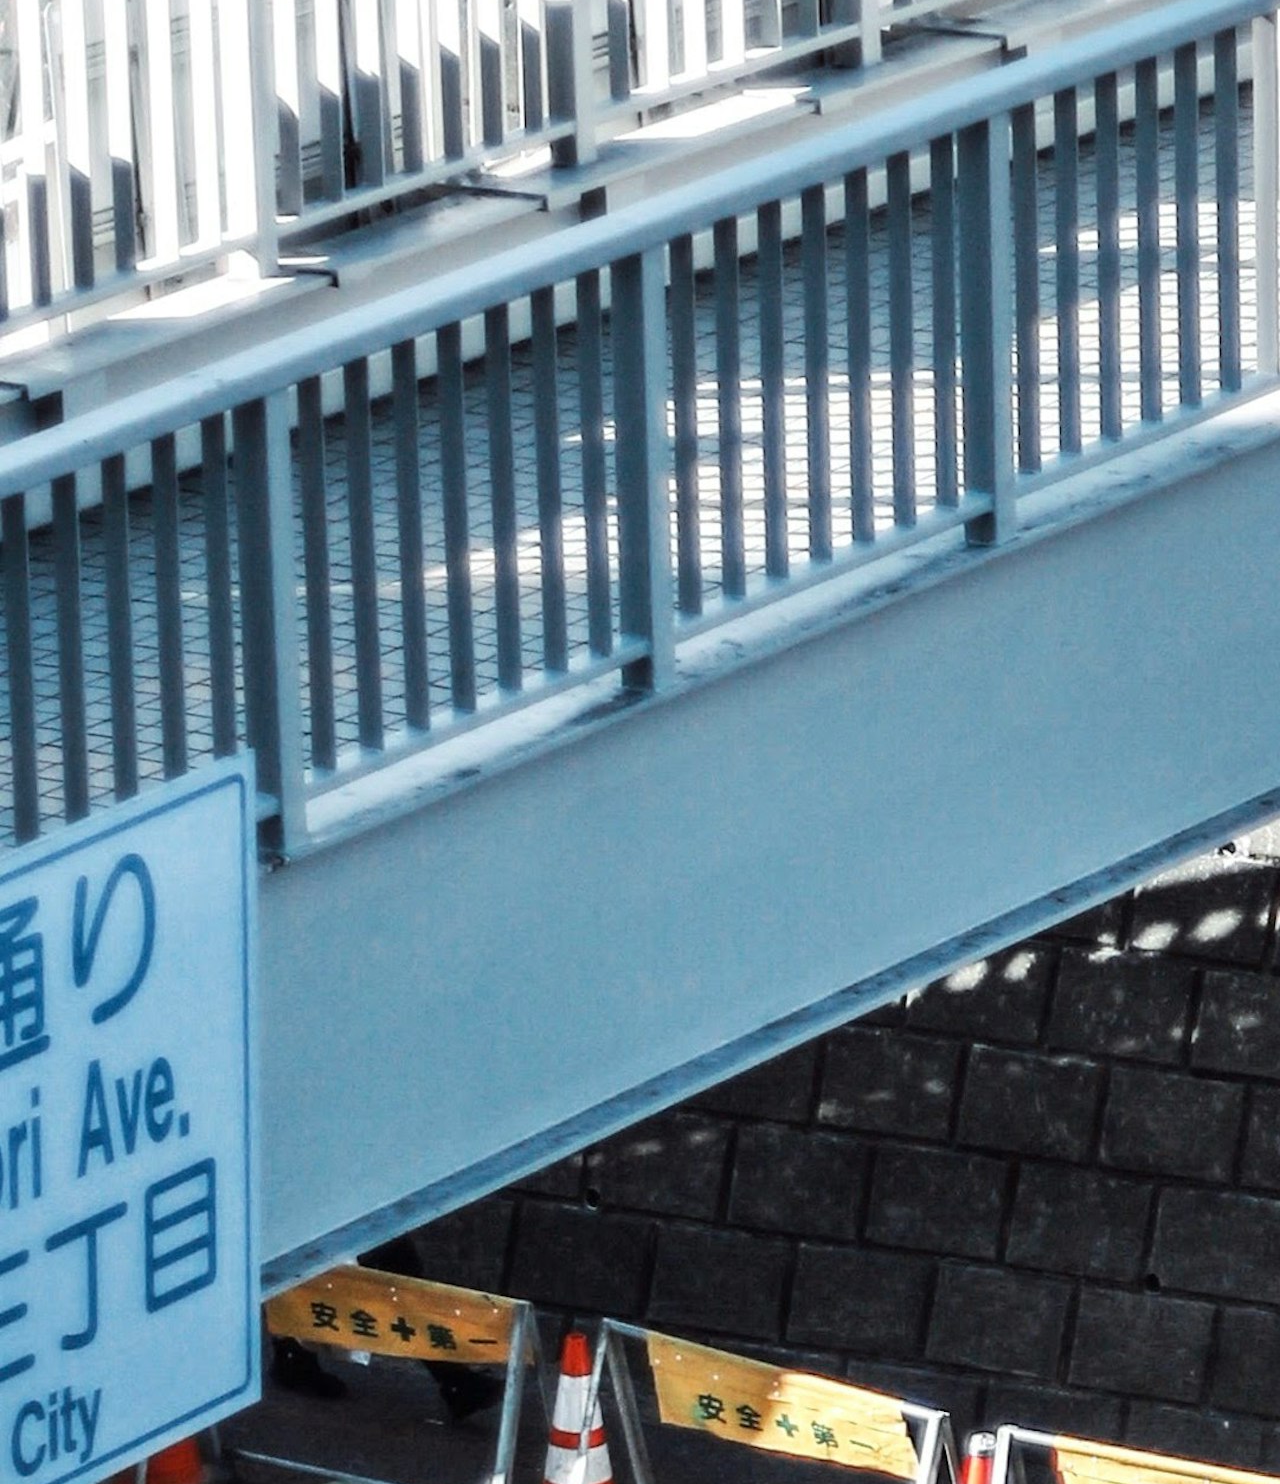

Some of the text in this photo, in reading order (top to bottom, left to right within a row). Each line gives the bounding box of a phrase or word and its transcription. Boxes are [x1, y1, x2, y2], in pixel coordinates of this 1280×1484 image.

[0, 1056, 190, 1210] ri Ave.
[11, 1386, 102, 1478] City
